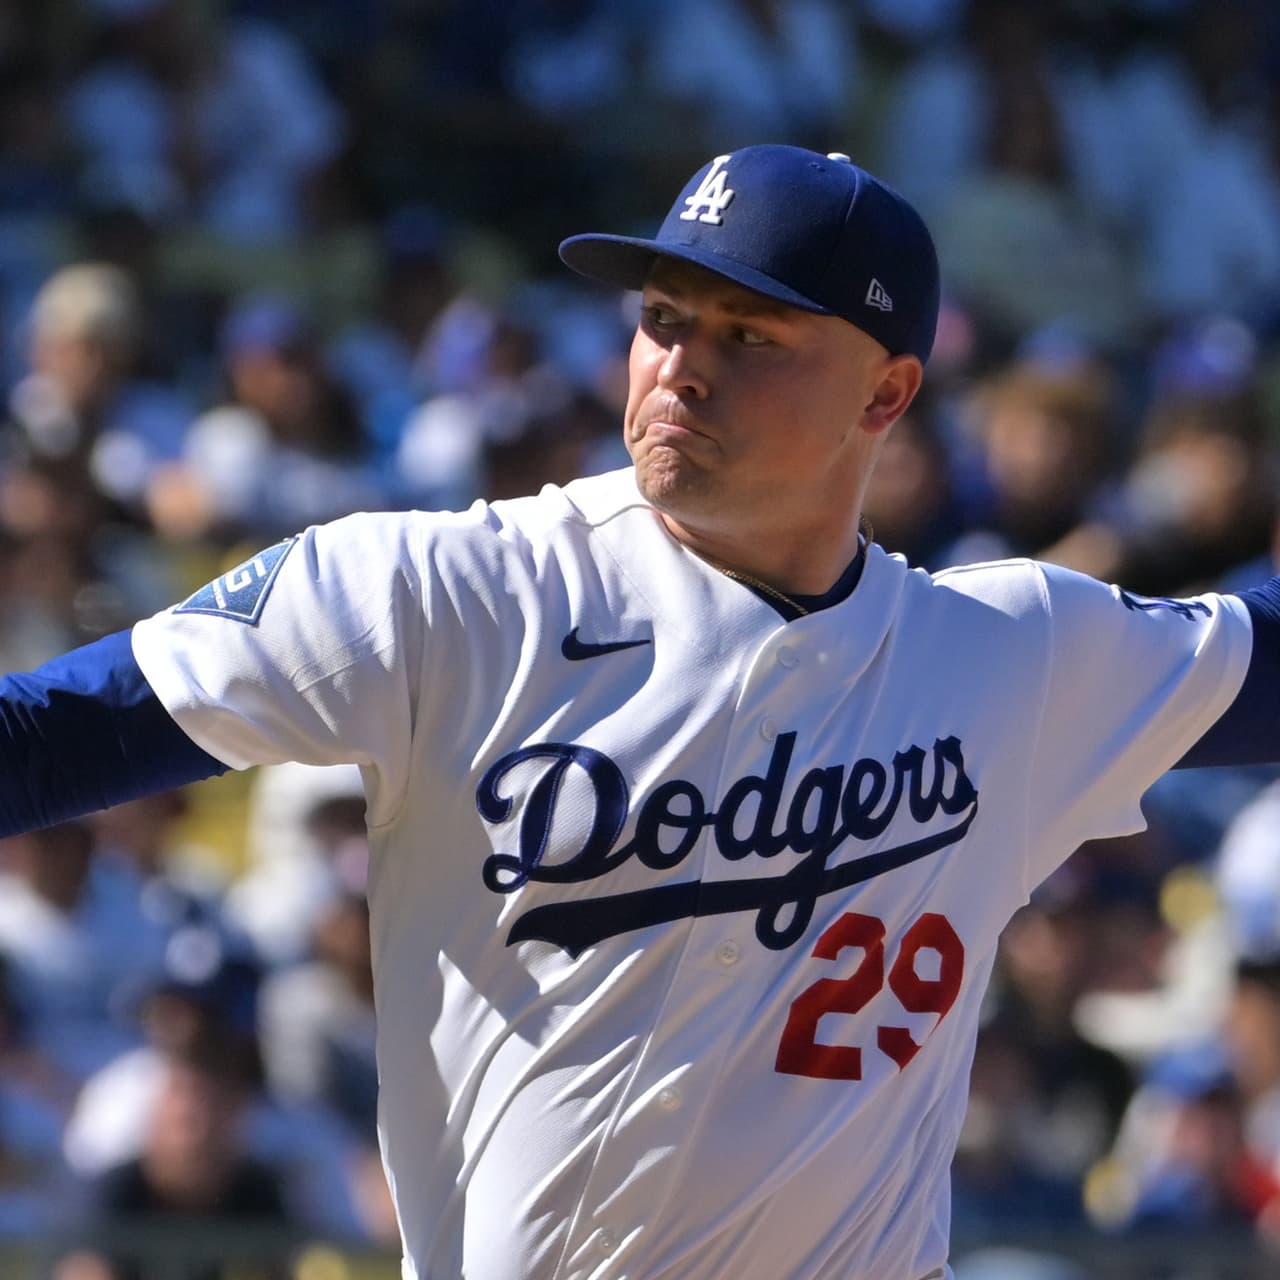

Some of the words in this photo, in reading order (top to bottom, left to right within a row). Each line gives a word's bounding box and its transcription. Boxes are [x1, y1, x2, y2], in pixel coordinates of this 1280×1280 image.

[679, 154, 735, 225] LA
[476, 731, 978, 951] Dodgers
[775, 912, 964, 1080] 29
